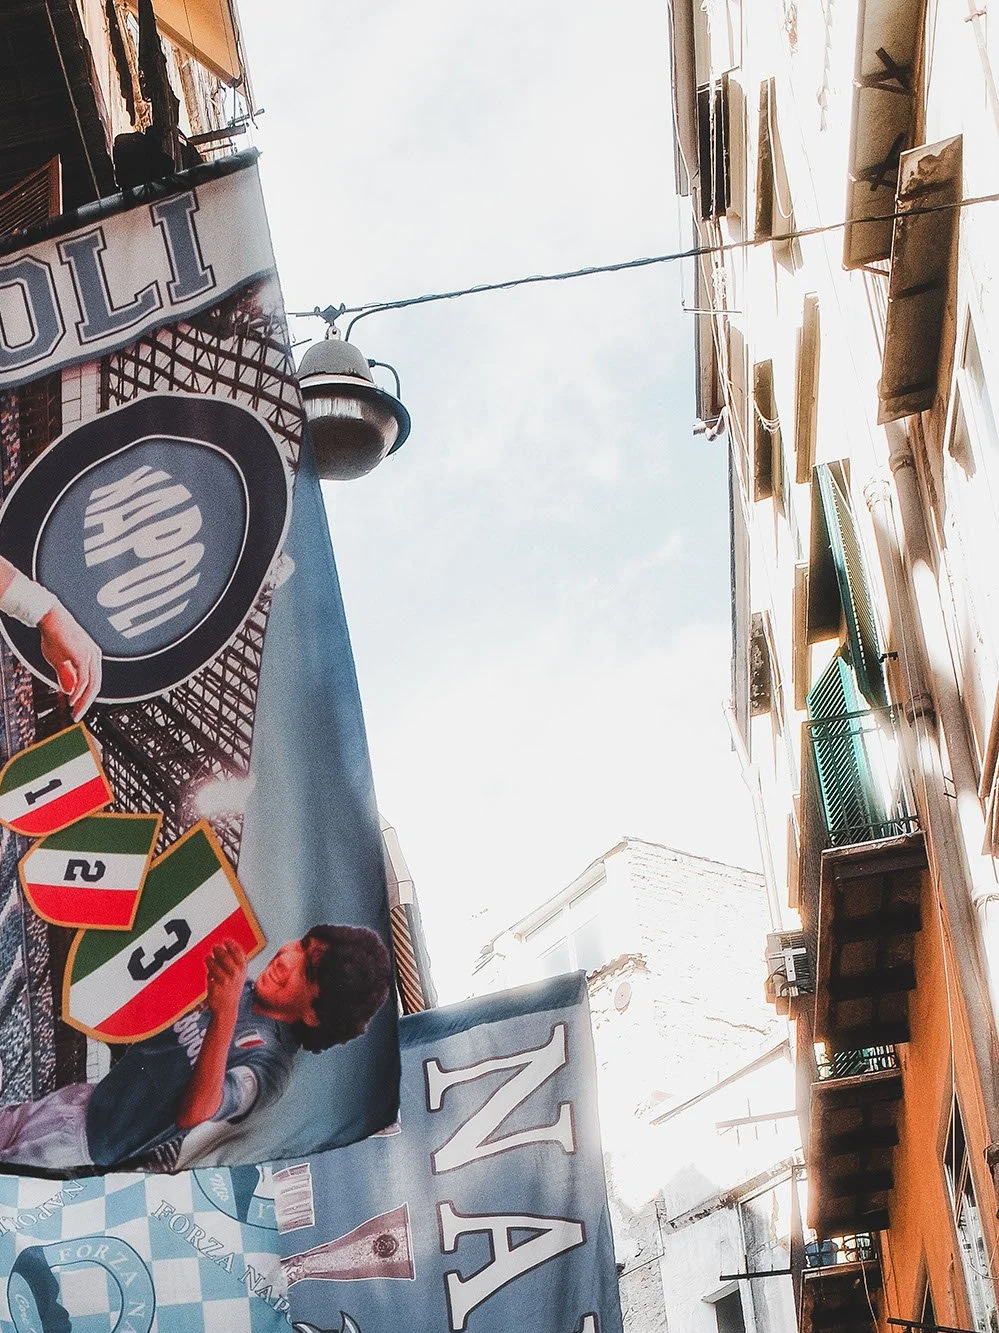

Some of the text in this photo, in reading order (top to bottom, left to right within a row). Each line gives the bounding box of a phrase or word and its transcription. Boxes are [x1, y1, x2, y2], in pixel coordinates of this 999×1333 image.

[83, 464, 204, 639] NAPOLI
[24, 778, 63, 806] 1
[63, 859, 106, 883] 2
[127, 919, 192, 981] 3
[58, 1244, 138, 1288] FORZA
[151, 1199, 292, 1325] FORZA NAP
